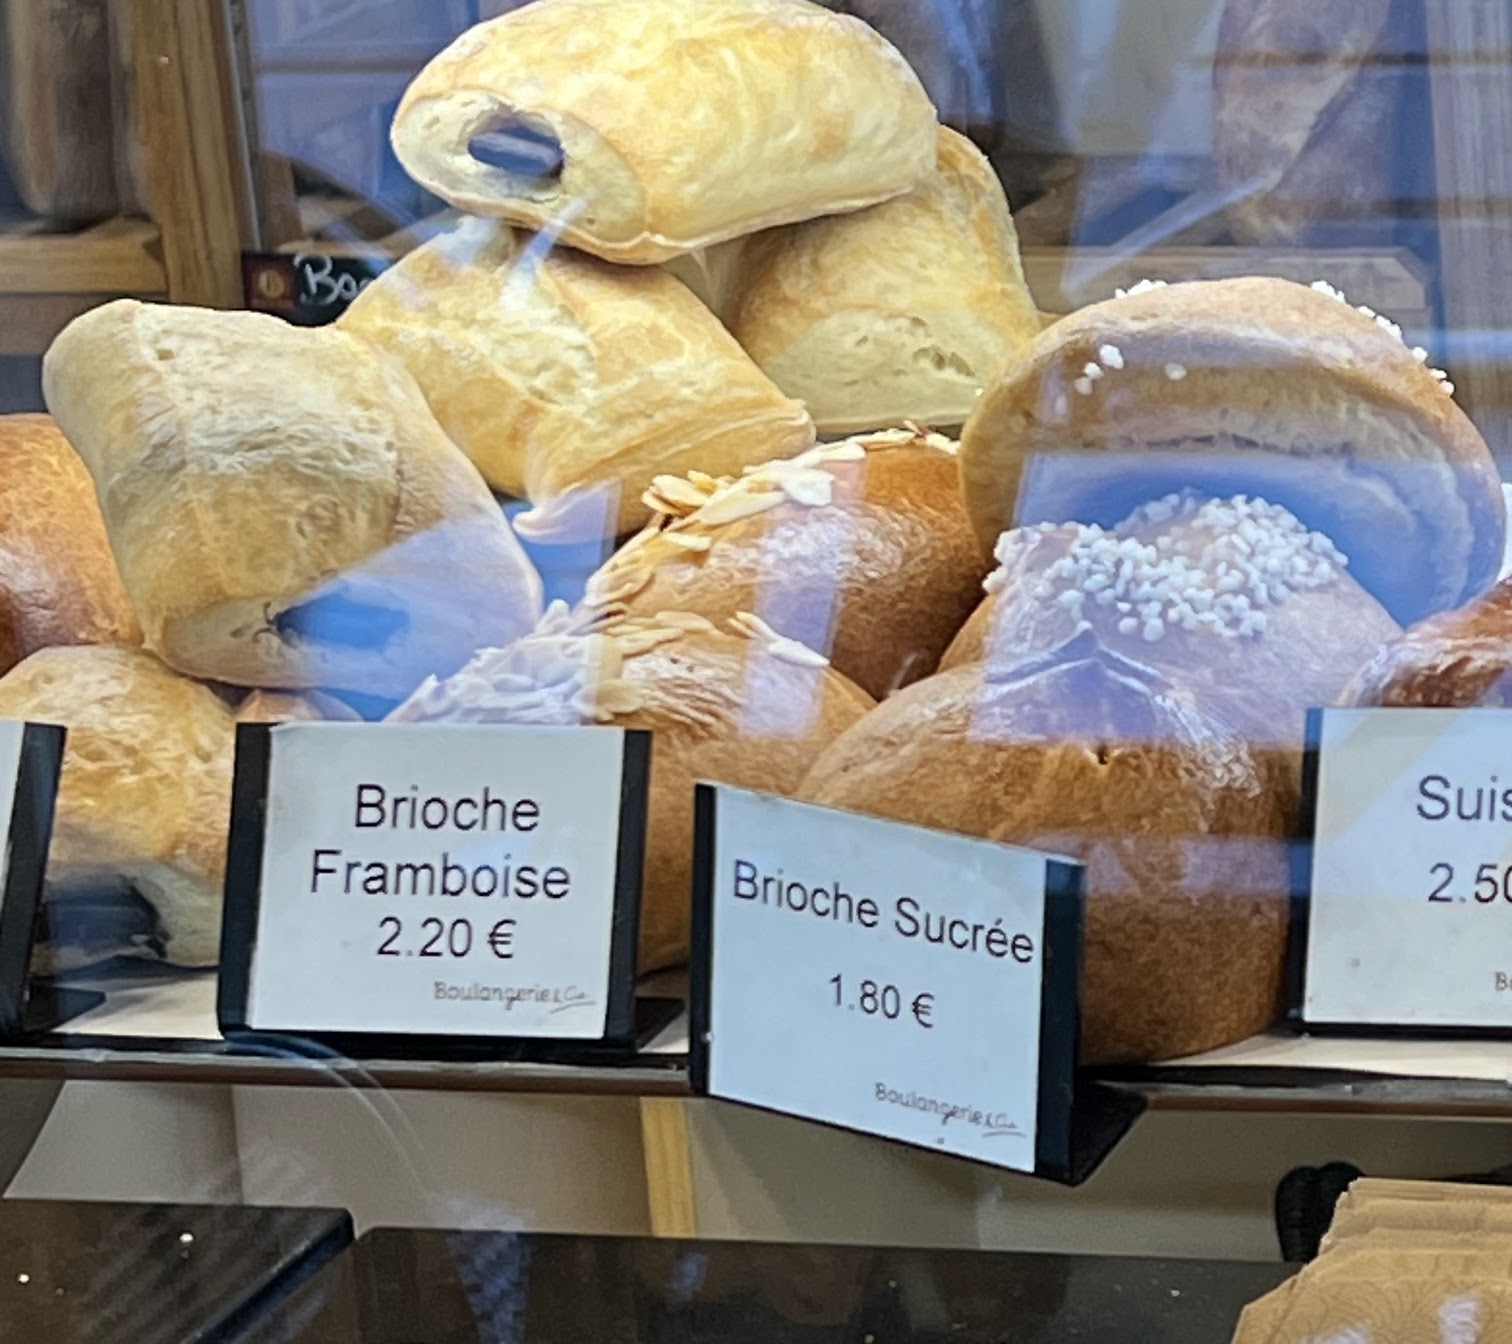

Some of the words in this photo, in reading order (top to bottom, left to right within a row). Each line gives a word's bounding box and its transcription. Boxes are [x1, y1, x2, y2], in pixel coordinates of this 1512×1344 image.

[353, 782, 541, 832] Brioche
[310, 849, 572, 900] Framboise
[376, 916, 474, 958] 2.20
[487, 918, 517, 959] €
[732, 859, 880, 930] Brioche
[894, 896, 1035, 965] Sucrée
[829, 973, 901, 1020] 1.80
[911, 991, 936, 1029] €
